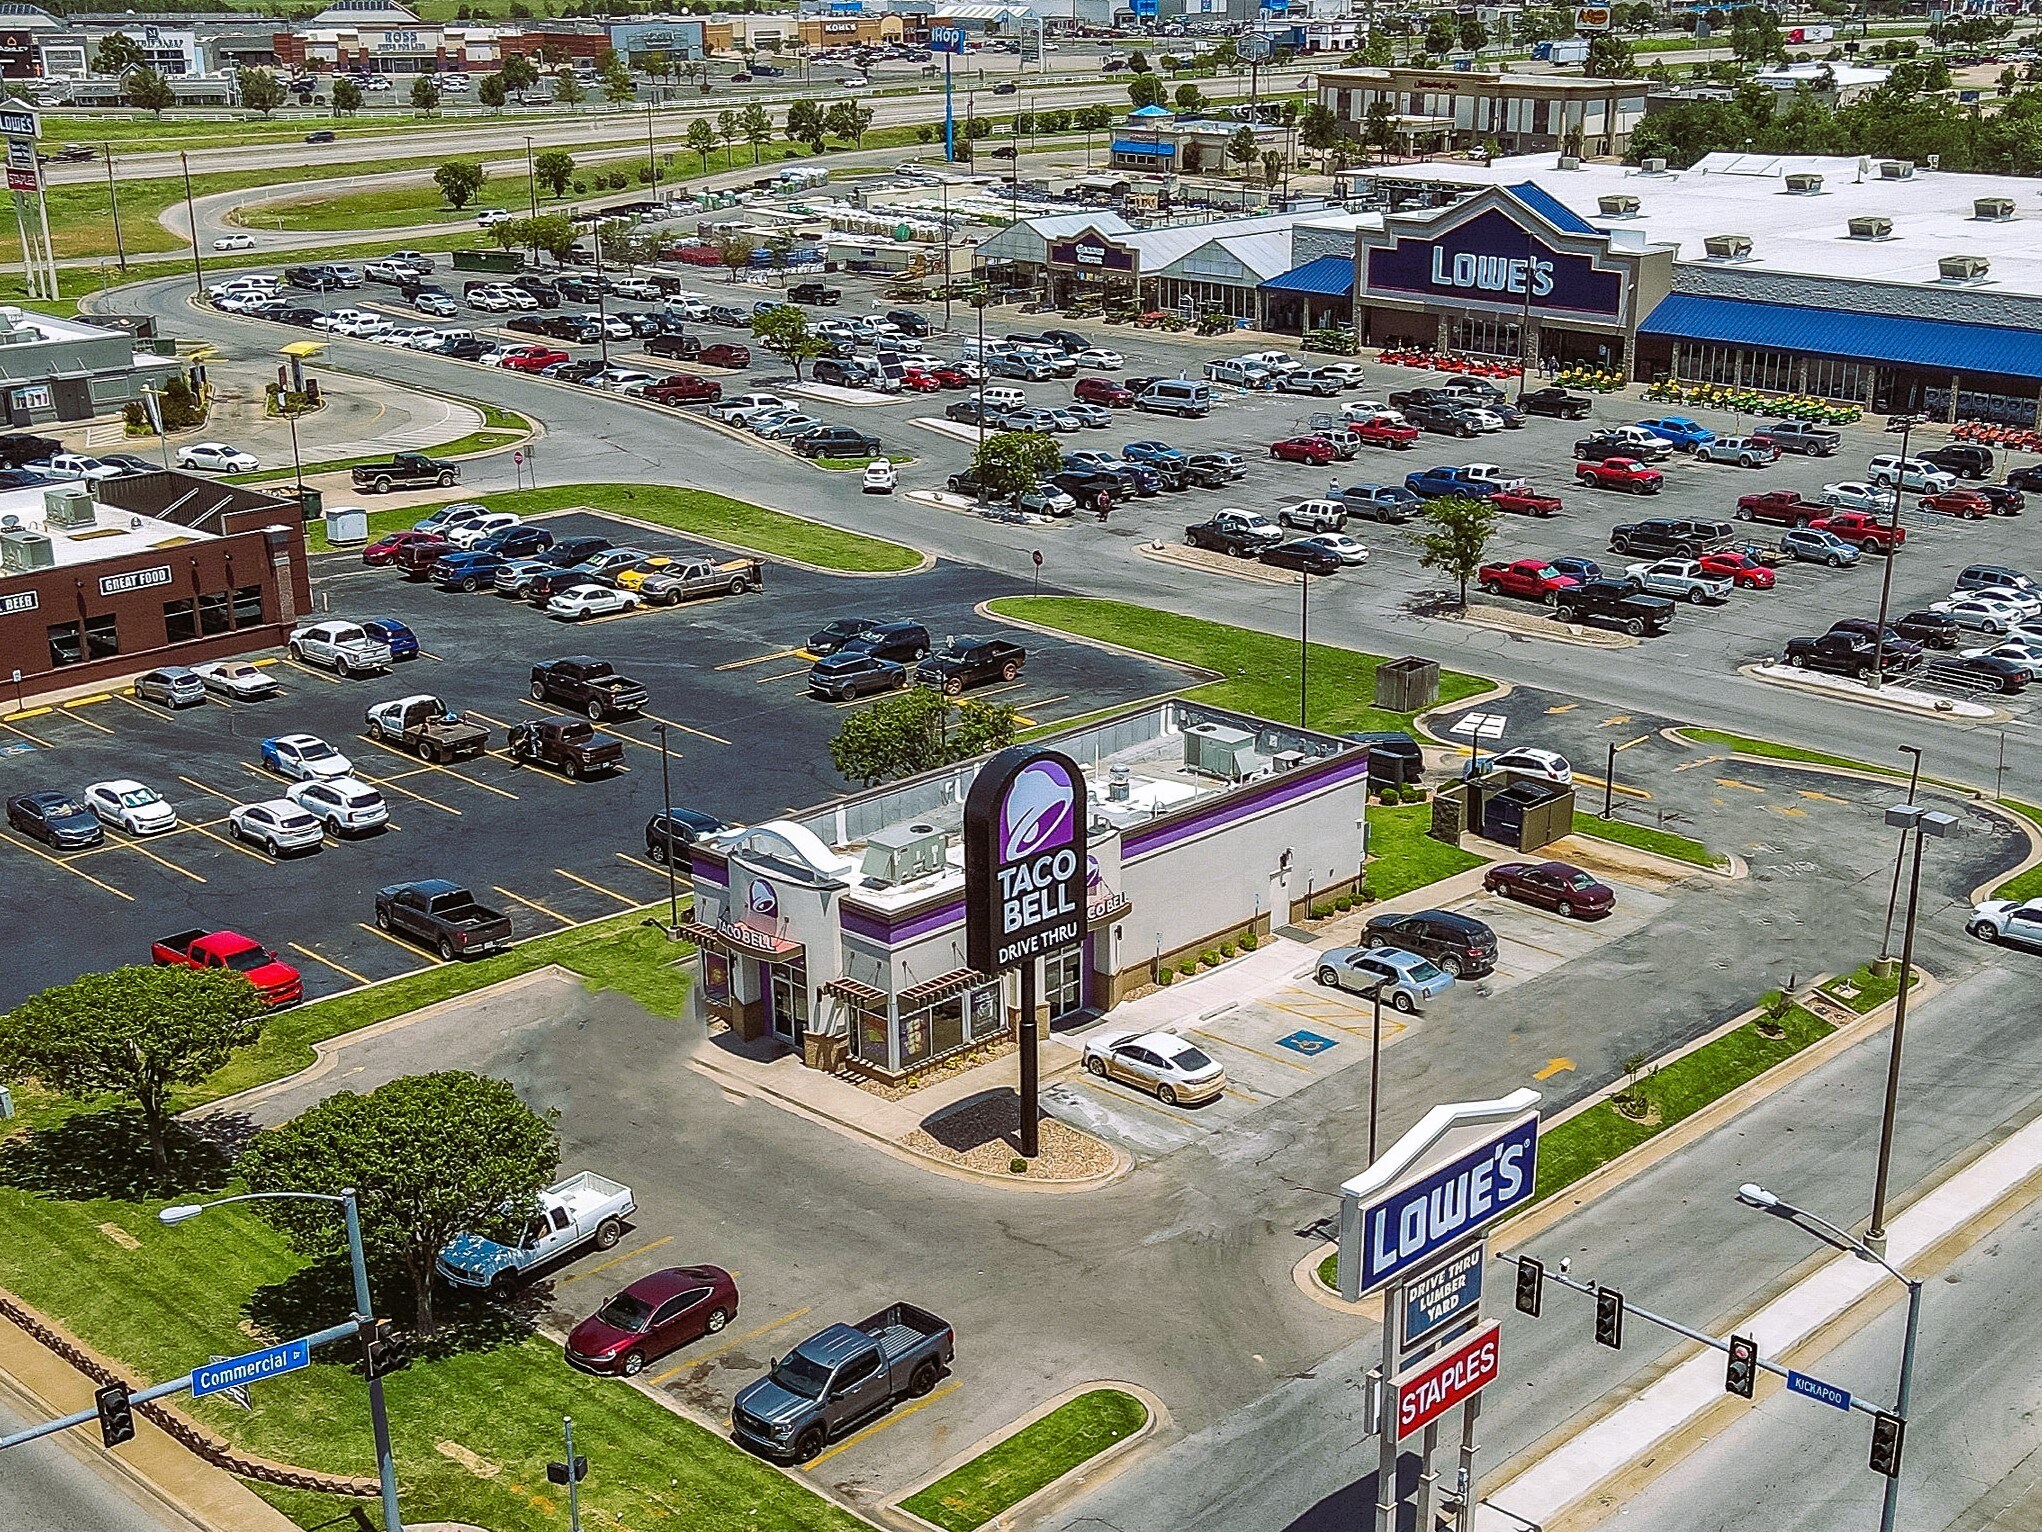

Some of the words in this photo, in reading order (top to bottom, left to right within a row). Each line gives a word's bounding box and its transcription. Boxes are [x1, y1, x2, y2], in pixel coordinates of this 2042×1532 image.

[385, 32, 418, 43] ROSS
[1431, 245, 1554, 296] LOWE'S
[105, 574, 139, 592] GREAT
[139, 569, 167, 585] FOOD
[5, 595, 33, 611] BEER
[997, 849, 1077, 900] TACO
[1004, 883, 1076, 934] BELL
[717, 917, 742, 940] TACO
[742, 930, 775, 951] BELL
[998, 935, 1039, 964] DRIVE
[1040, 921, 1078, 948] THRU
[1373, 1142, 1523, 1275] LOWE'S
[1409, 1273, 1445, 1303] DRIVE
[1448, 1250, 1480, 1280] THRU
[1419, 1274, 1467, 1312] LUMBER
[1427, 1294, 1459, 1323] YARD
[200, 1350, 287, 1389] Commercial
[1401, 1342, 1495, 1425] STAPLES
[1795, 1377, 1842, 1404] KICKAPOO
